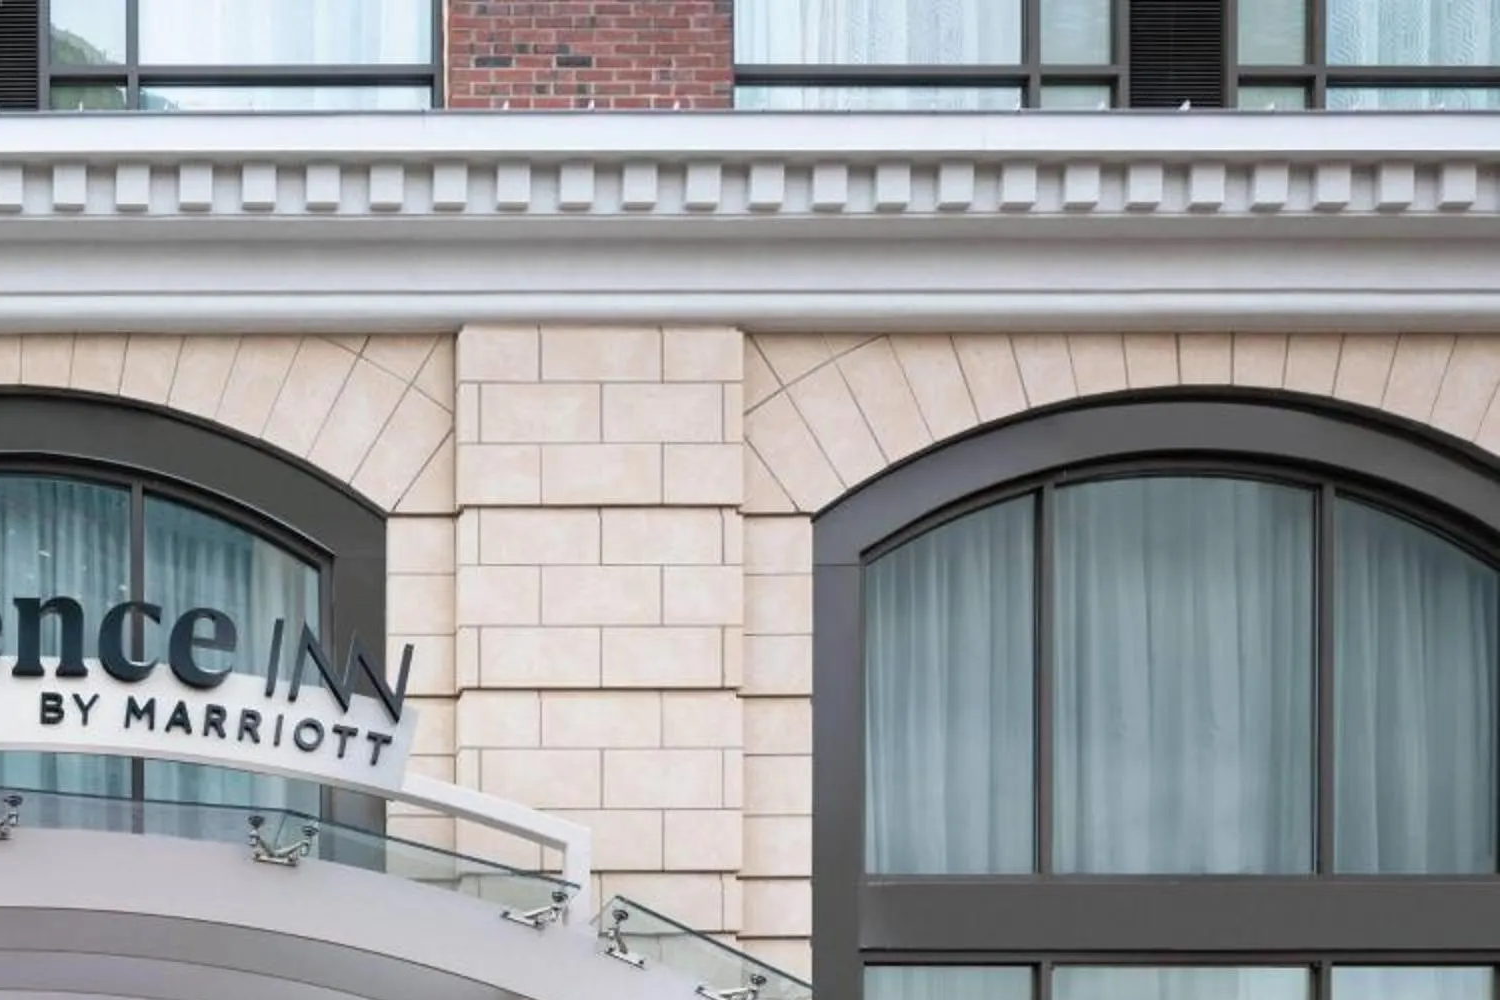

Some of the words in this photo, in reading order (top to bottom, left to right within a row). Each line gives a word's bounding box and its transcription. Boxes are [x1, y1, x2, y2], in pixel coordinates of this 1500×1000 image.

[265, 617, 416, 723] INN
[39, 692, 101, 726] BY
[124, 695, 395, 767] MARRIOTT
